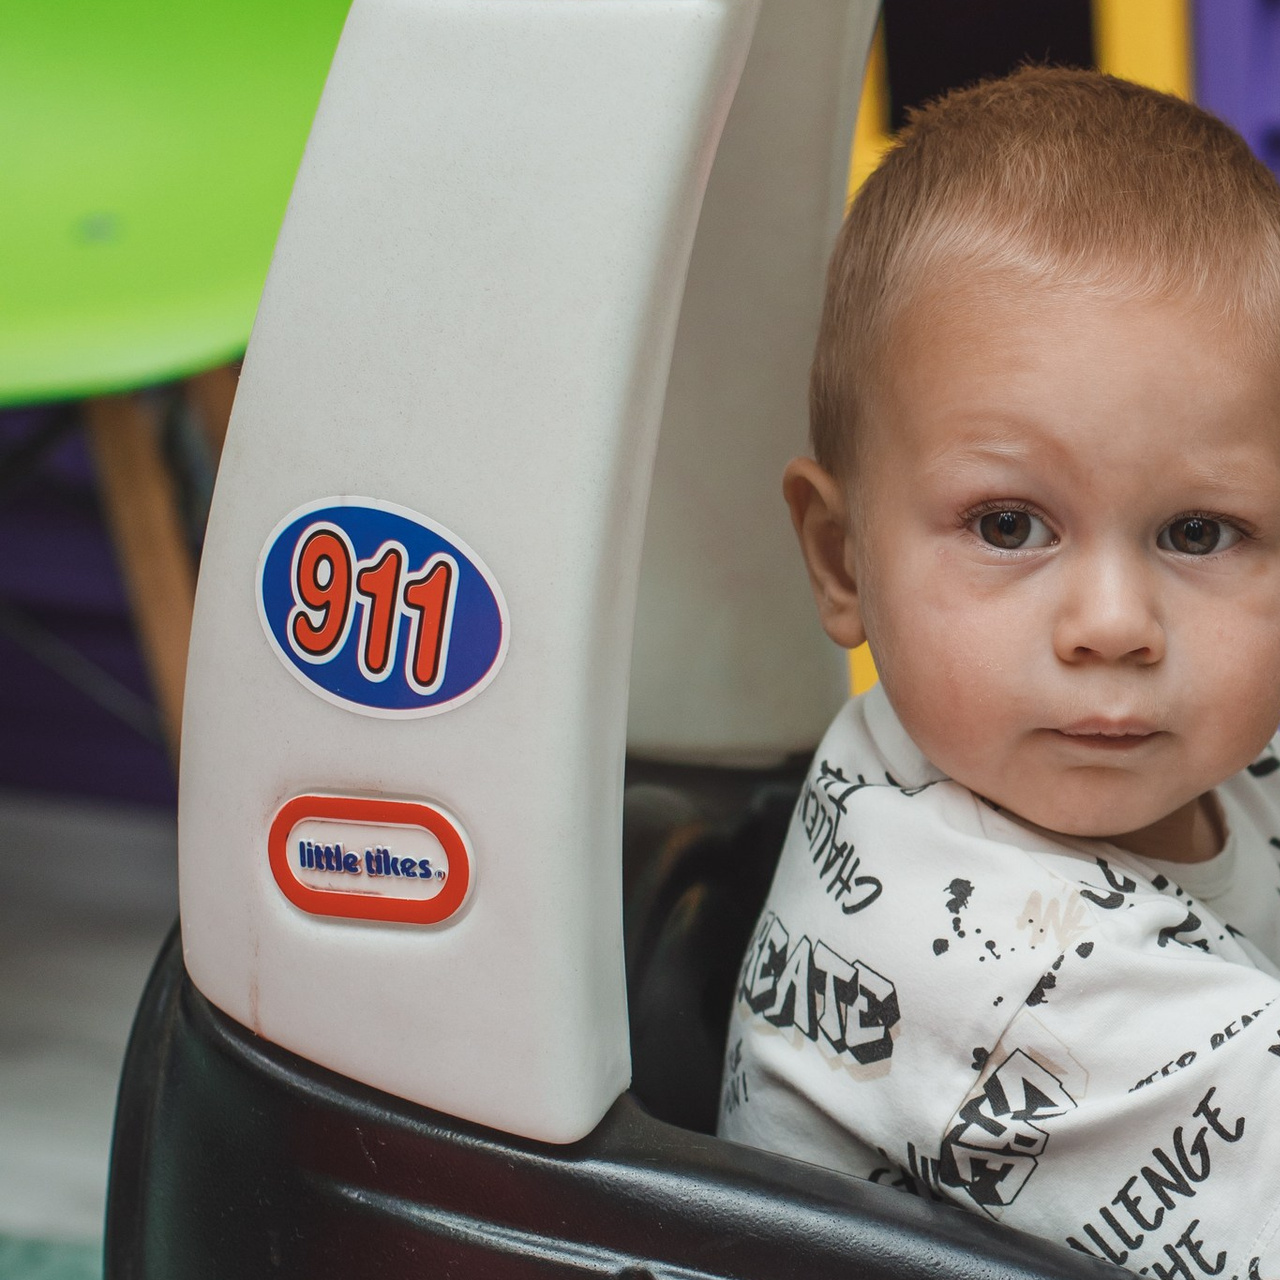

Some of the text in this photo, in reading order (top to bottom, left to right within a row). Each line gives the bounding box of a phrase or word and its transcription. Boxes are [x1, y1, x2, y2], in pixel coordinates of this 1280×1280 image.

[293, 528, 453, 688] 911
[299, 840, 360, 874] little
[740, 912, 901, 1065] EATE
[1065, 1086, 1246, 1267] LLENGE
